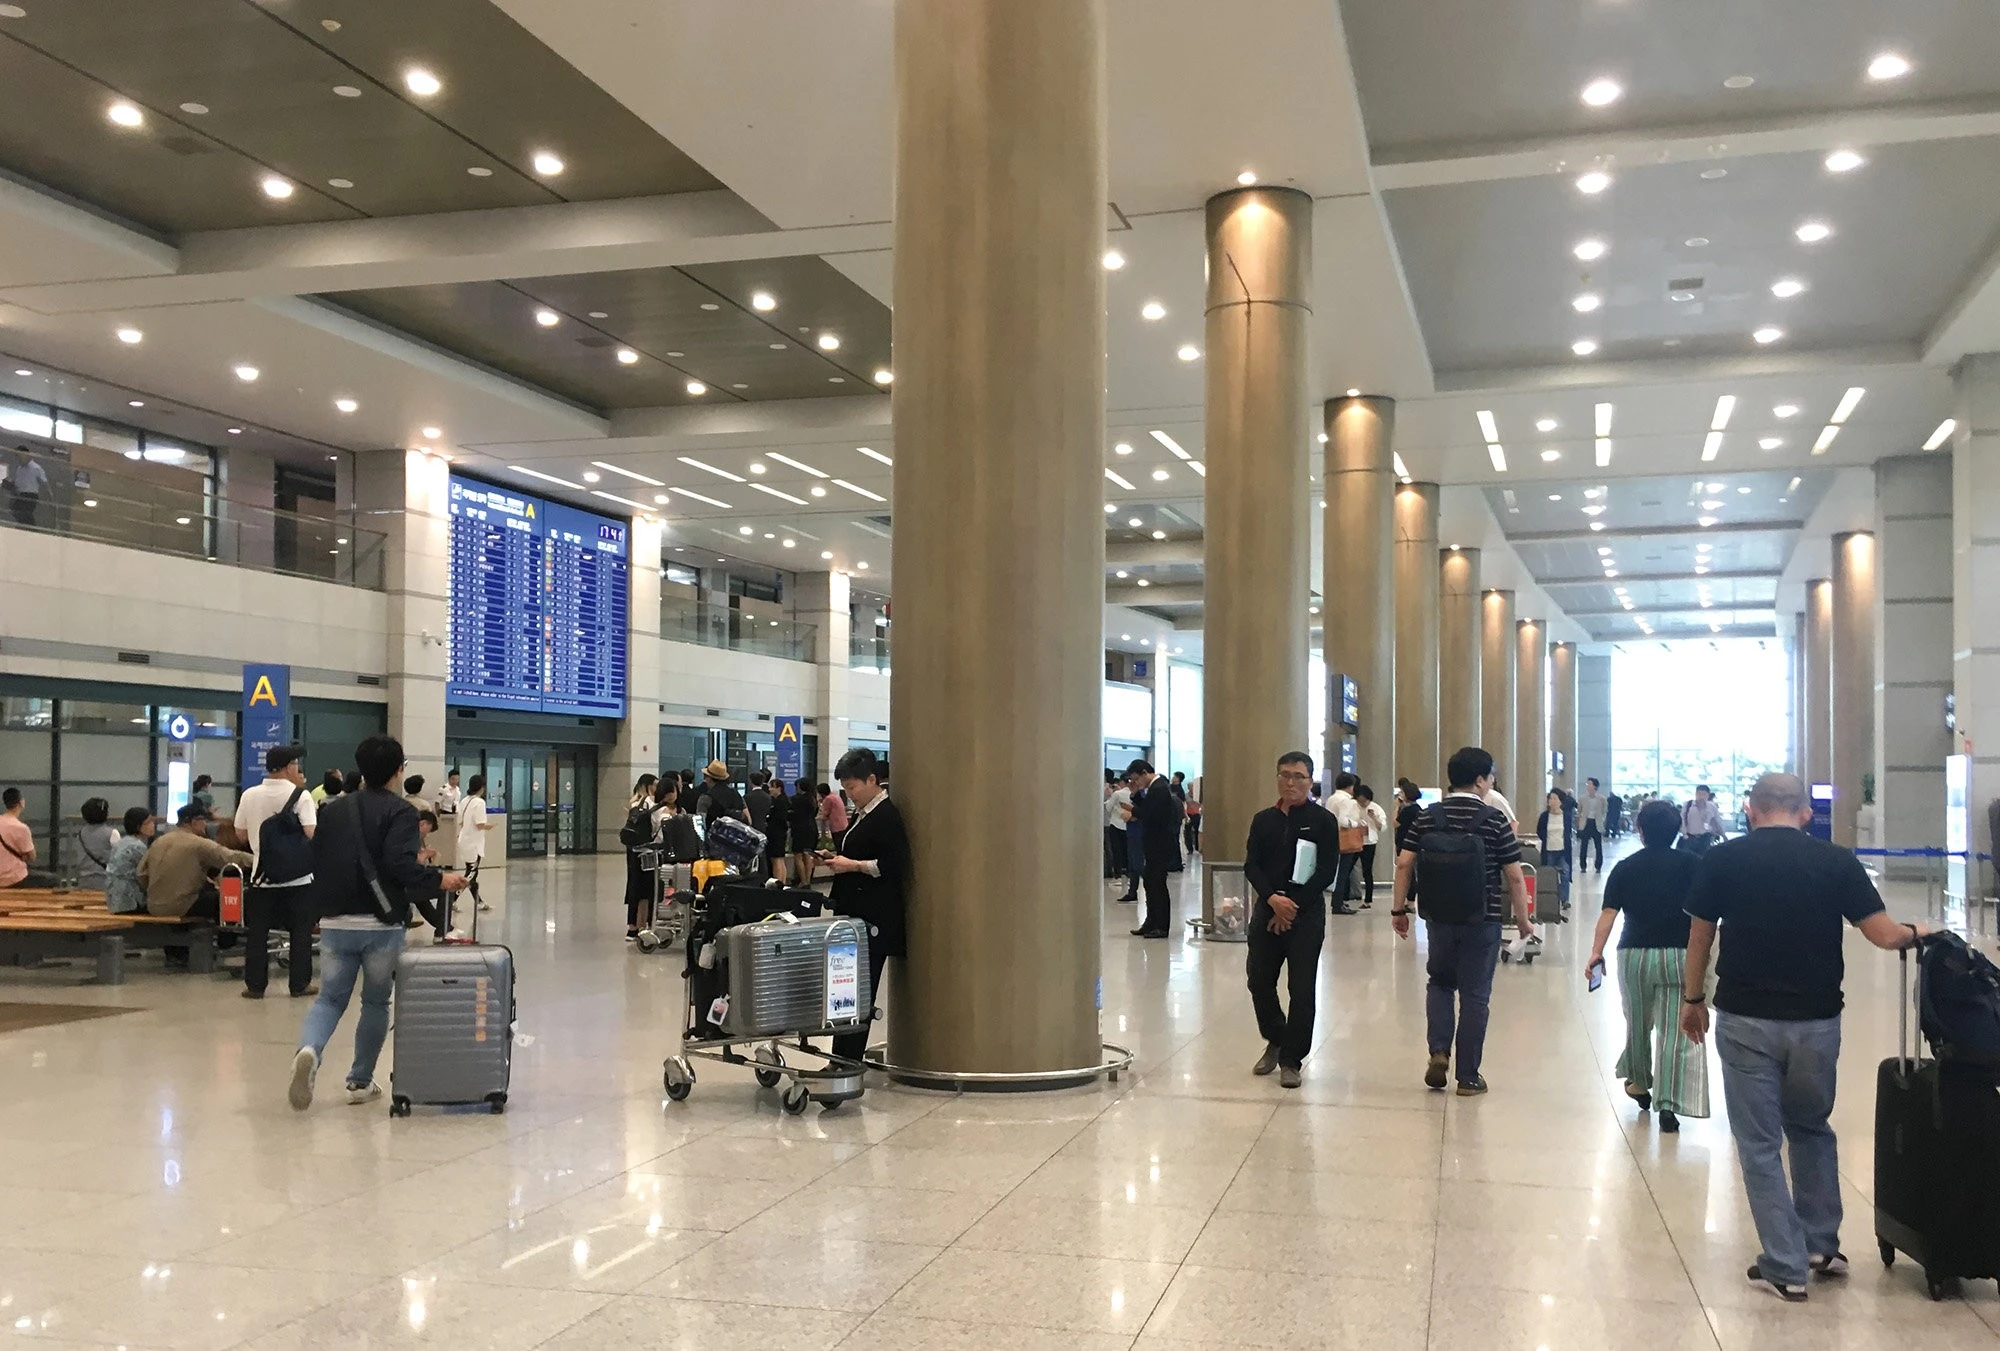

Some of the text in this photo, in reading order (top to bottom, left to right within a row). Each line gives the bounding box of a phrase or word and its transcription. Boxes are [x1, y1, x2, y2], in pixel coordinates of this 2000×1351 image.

[525, 503, 535, 519] A
[249, 675, 277, 707] A
[778, 723, 796, 742] A
